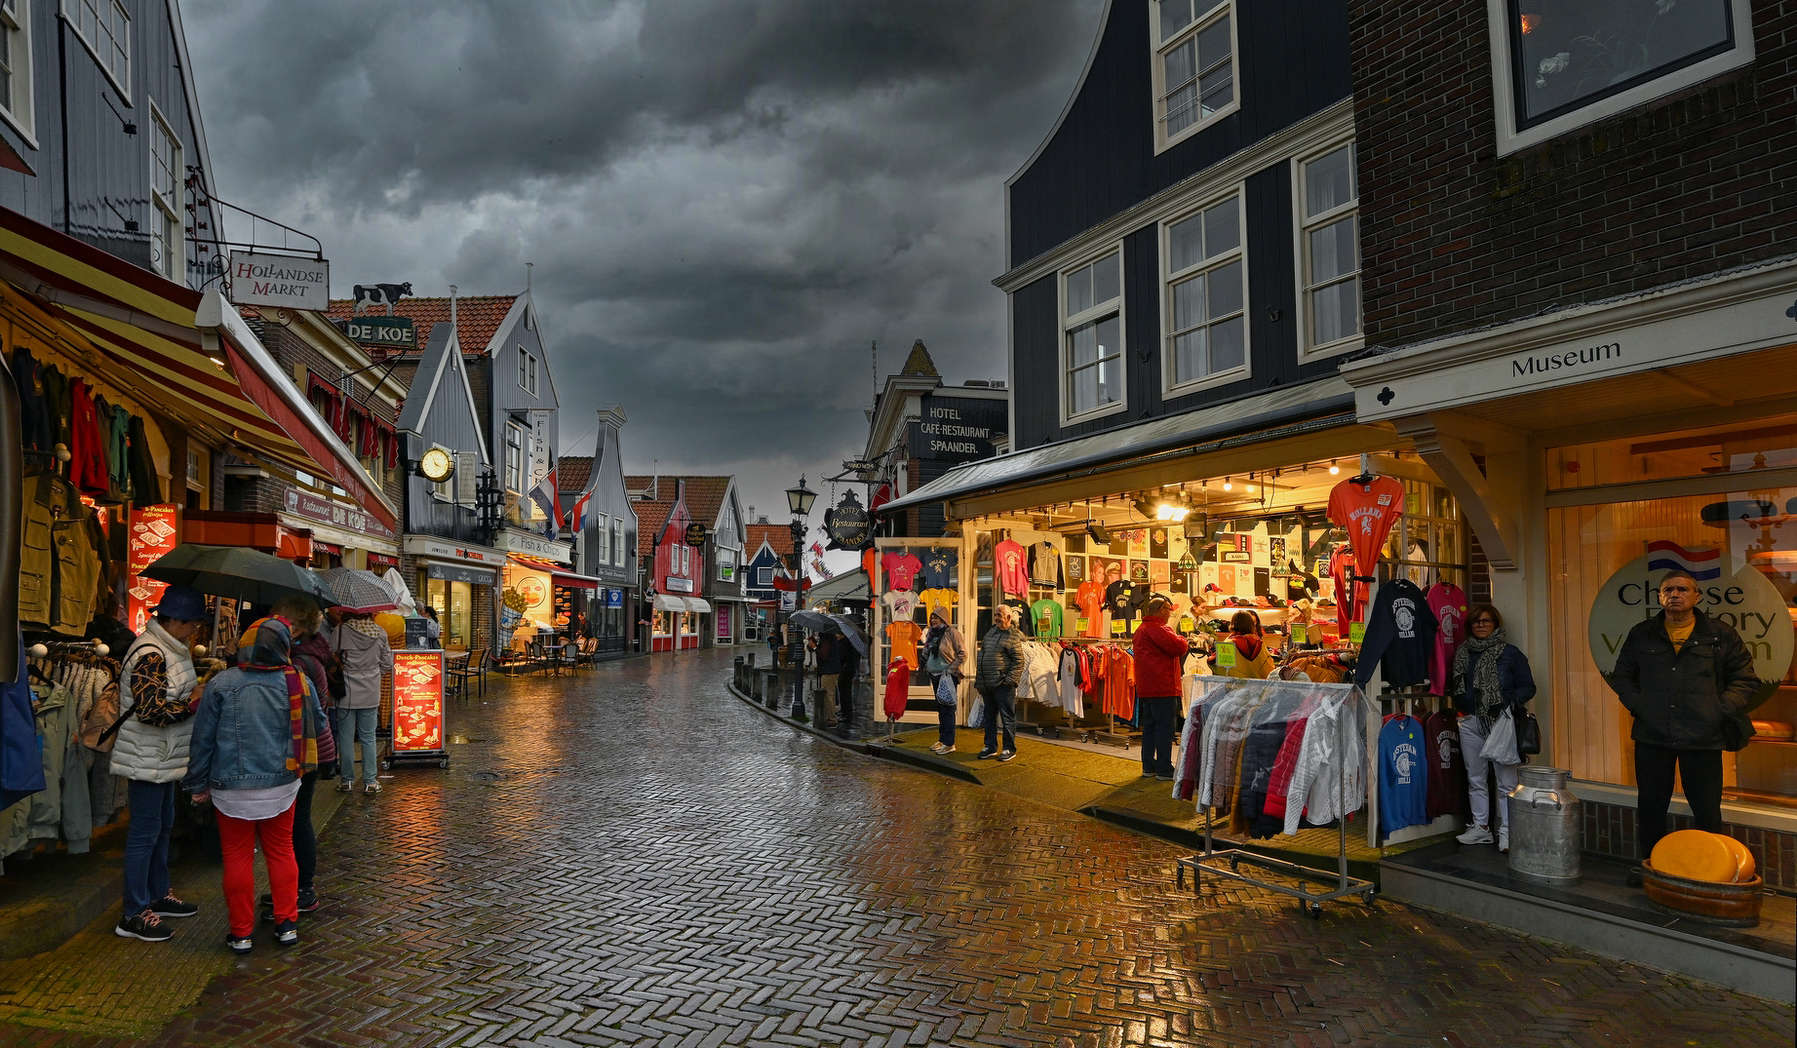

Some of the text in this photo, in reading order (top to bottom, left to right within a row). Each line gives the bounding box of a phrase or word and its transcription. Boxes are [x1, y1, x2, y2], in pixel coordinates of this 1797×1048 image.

[236, 262, 324, 284] HOLLANDSE
[252, 281, 310, 297] MARKT
[349, 324, 413, 342] DE KOE
[1512, 342, 1621, 377] Museum
[930, 407, 961, 420] HOTEL
[332, 505, 346, 525] DE
[348, 511, 366, 531] KOE
[832, 518, 869, 529] Restaurant
[521, 536, 535, 550] Fish
[1618, 581, 1745, 606] Chse
